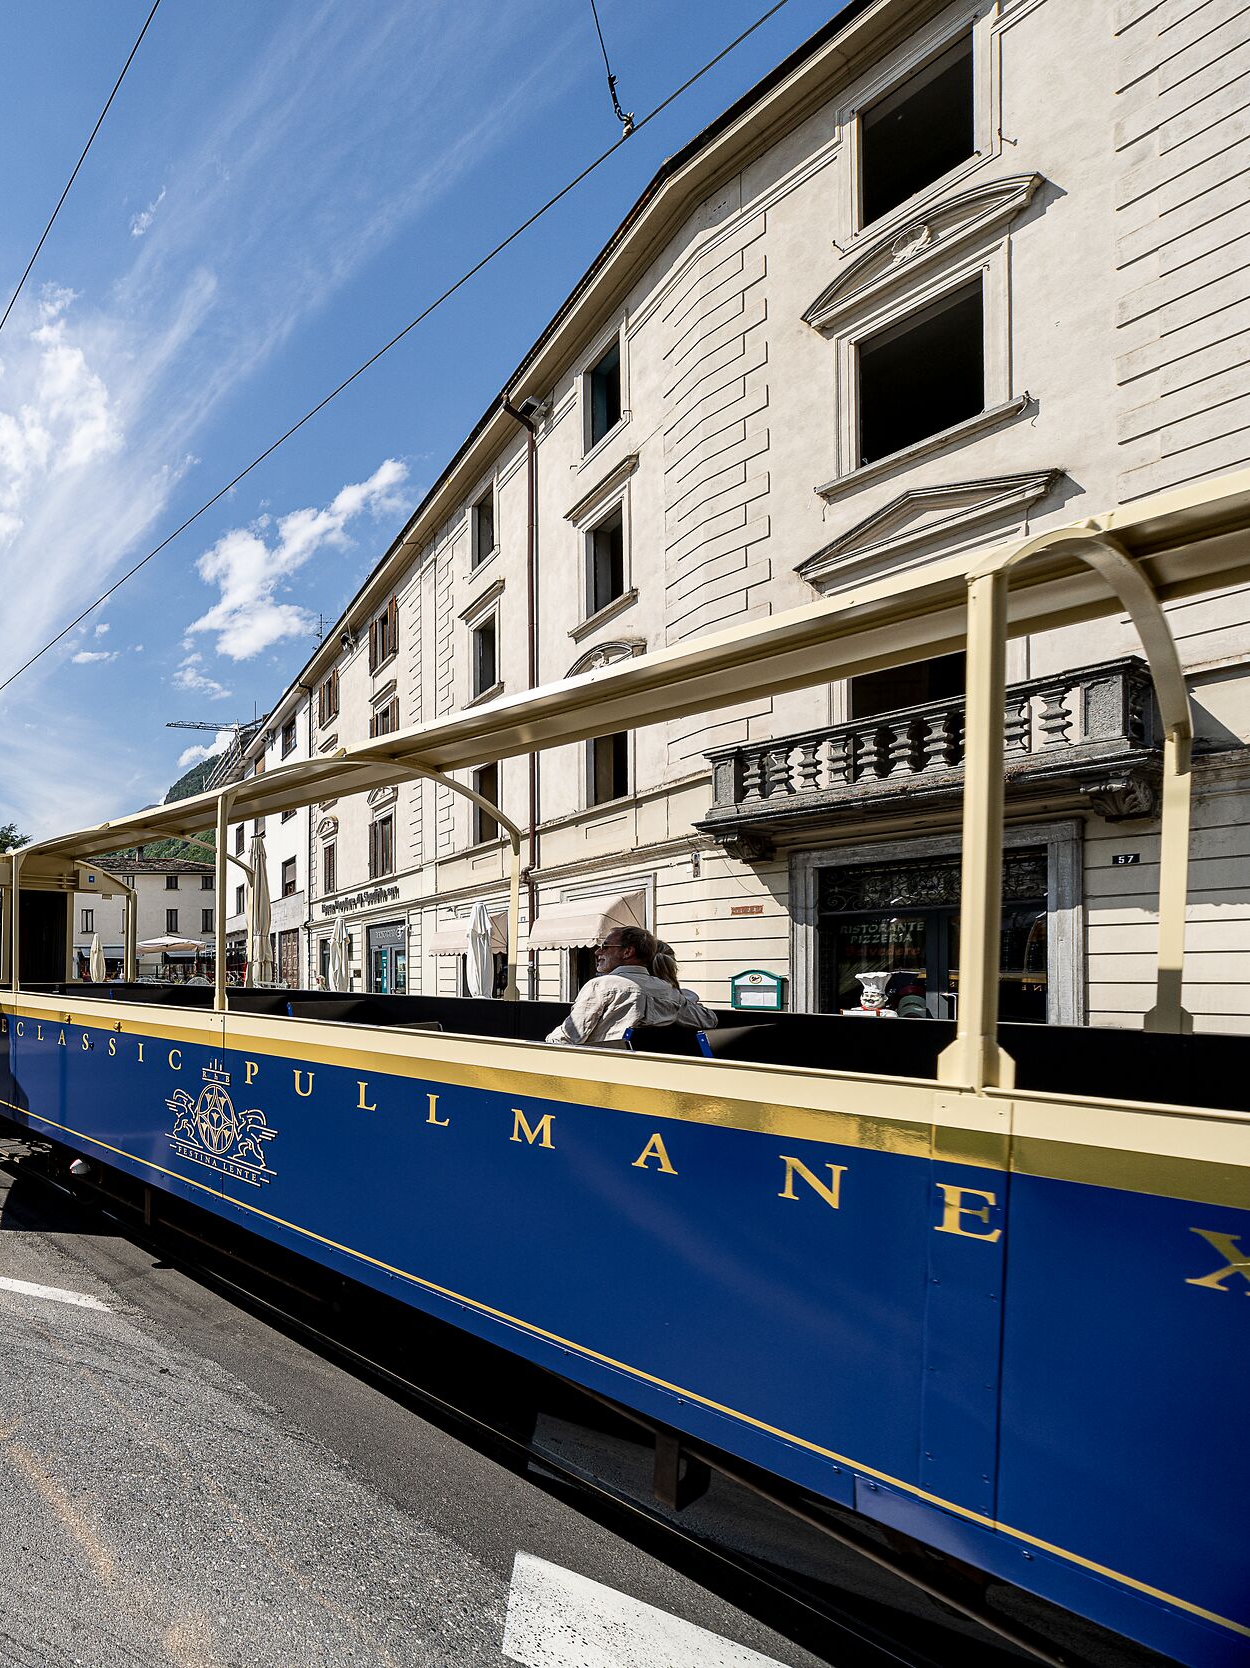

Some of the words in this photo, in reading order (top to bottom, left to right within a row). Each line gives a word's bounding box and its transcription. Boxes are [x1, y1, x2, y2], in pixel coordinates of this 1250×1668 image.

[1118, 855, 1135, 864] 57
[840, 921, 925, 934] RISTORANTE
[850, 932, 913, 944] PIZZERIA
[16, 1021, 182, 1071] CLASSIC
[245, 1060, 848, 1210] PULLMAN
[178, 1147, 218, 1167] FESTINA
[223, 1162, 258, 1182] LENTE
